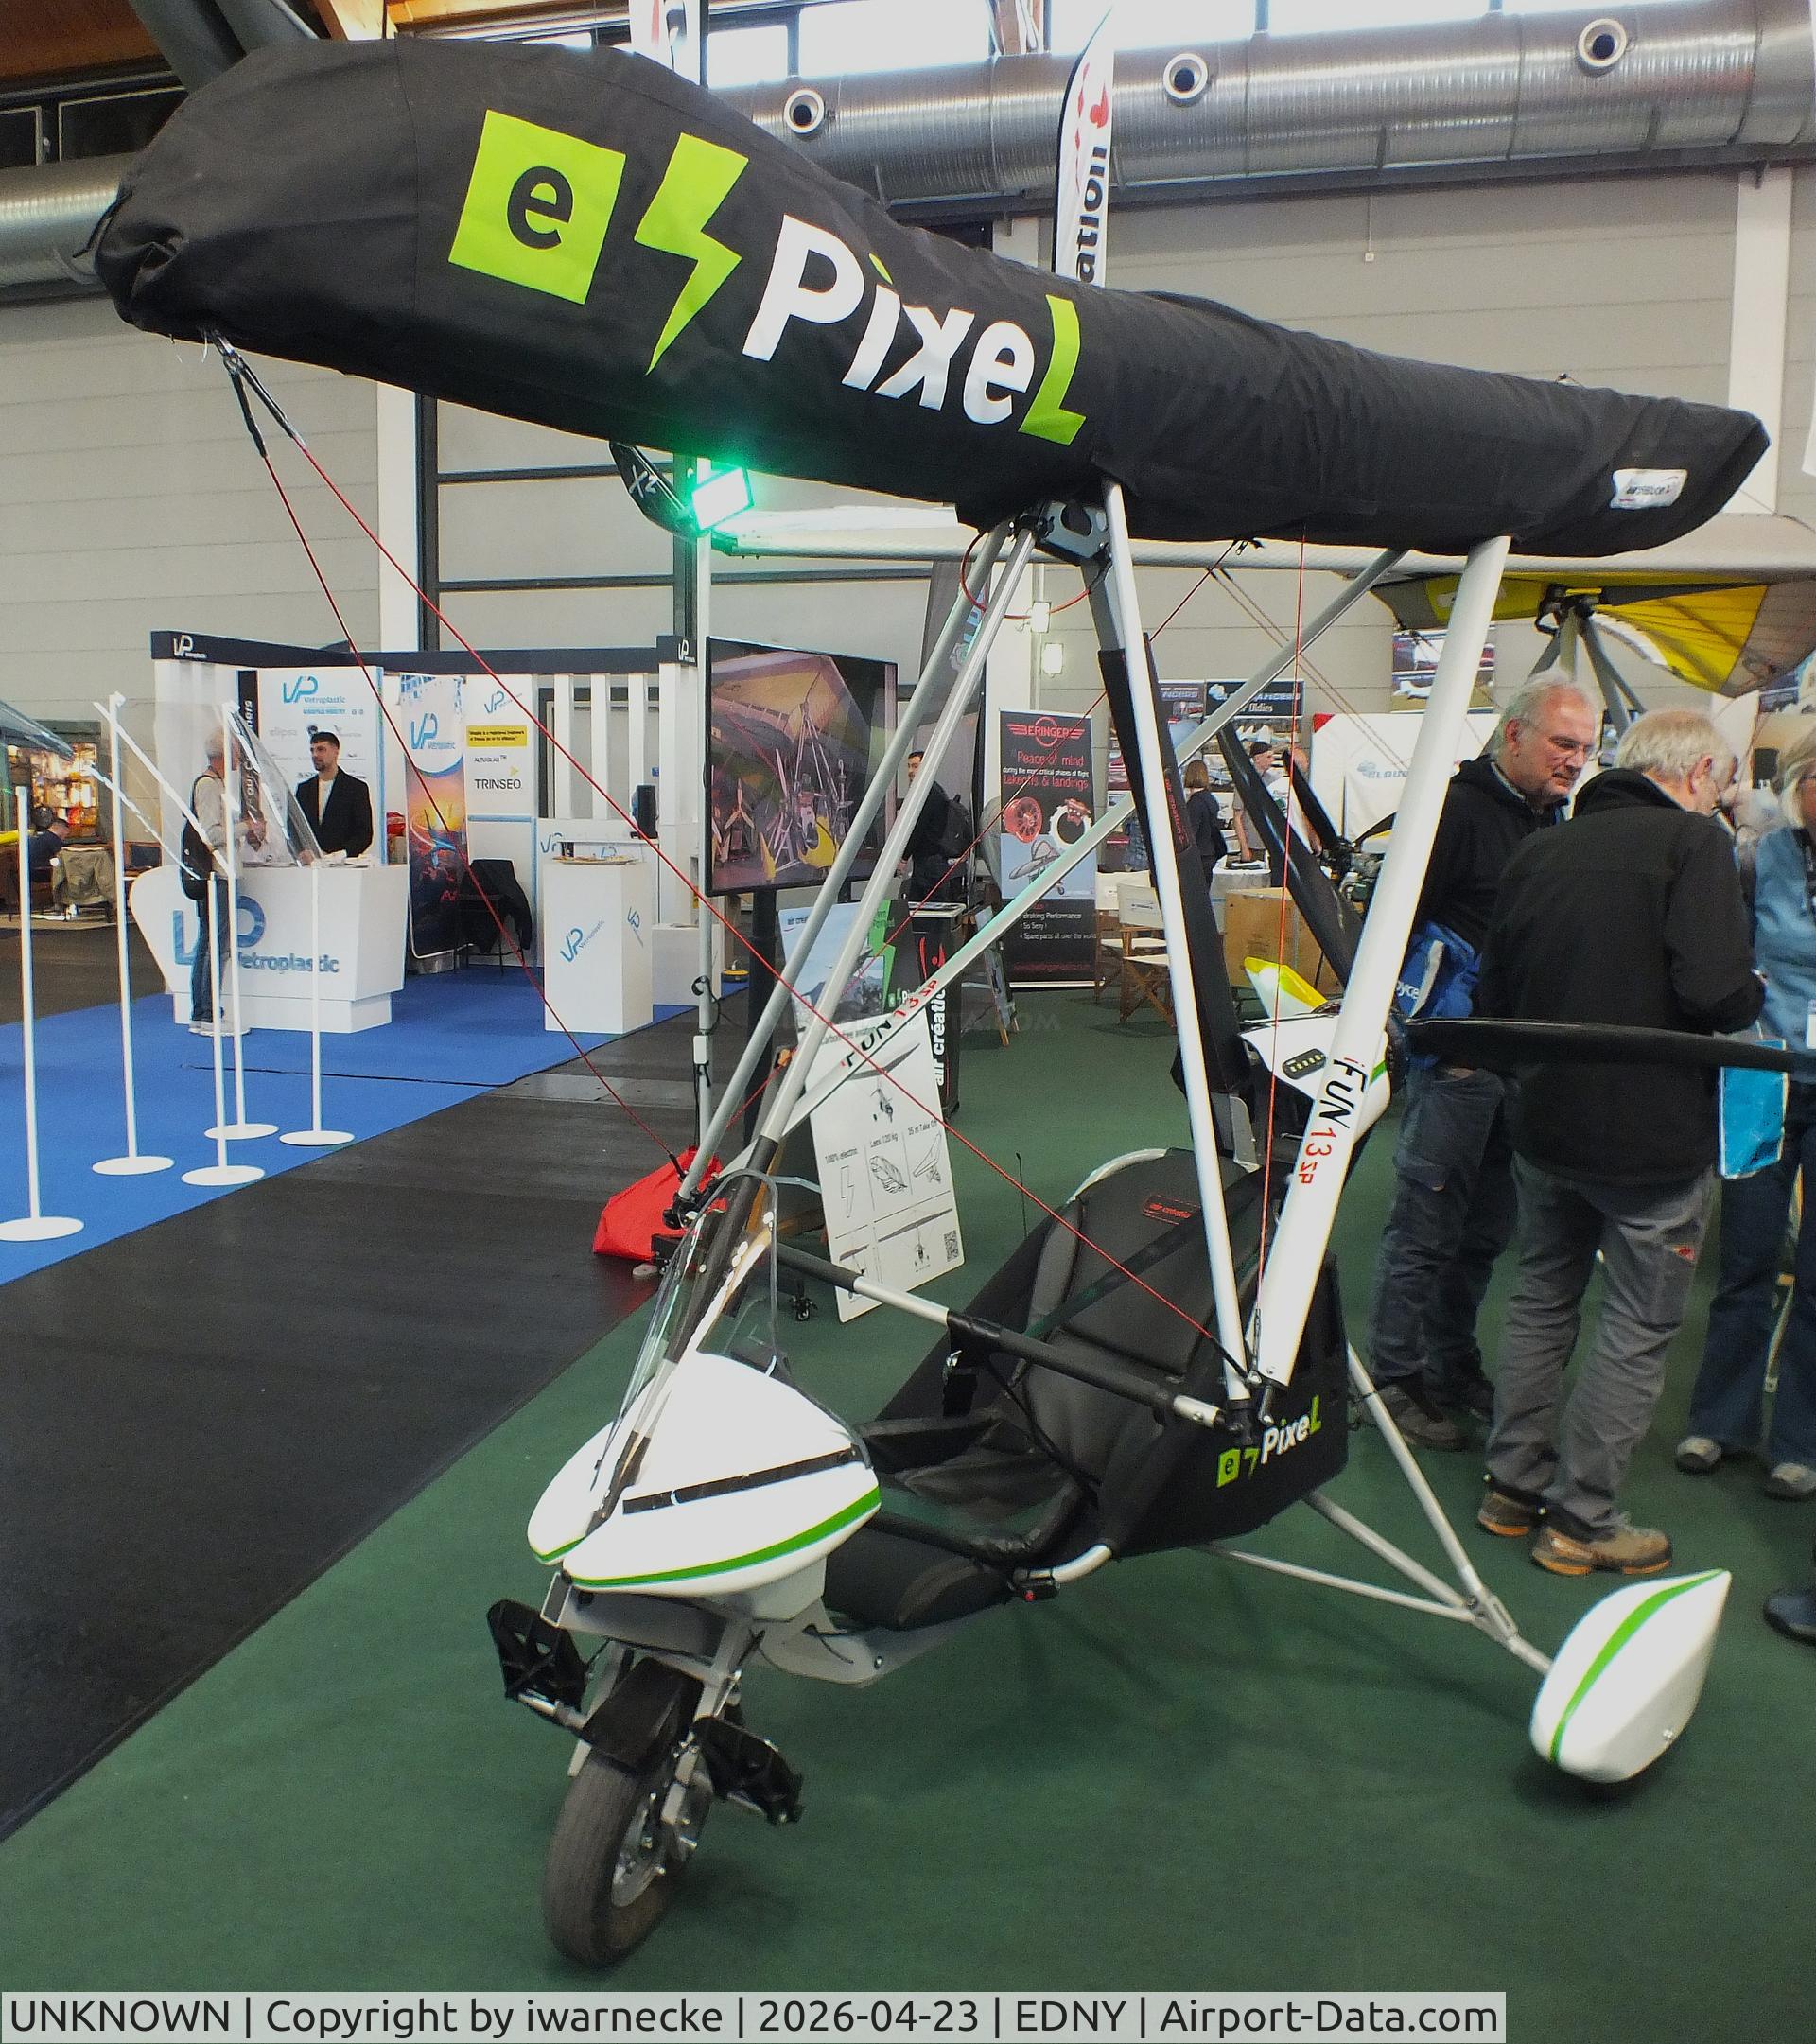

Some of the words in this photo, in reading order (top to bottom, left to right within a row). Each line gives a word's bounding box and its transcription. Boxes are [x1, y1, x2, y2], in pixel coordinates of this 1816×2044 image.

[506, 166, 573, 249] e
[475, 779, 521, 790] TRINSEO
[1052, 777, 1089, 791] landings
